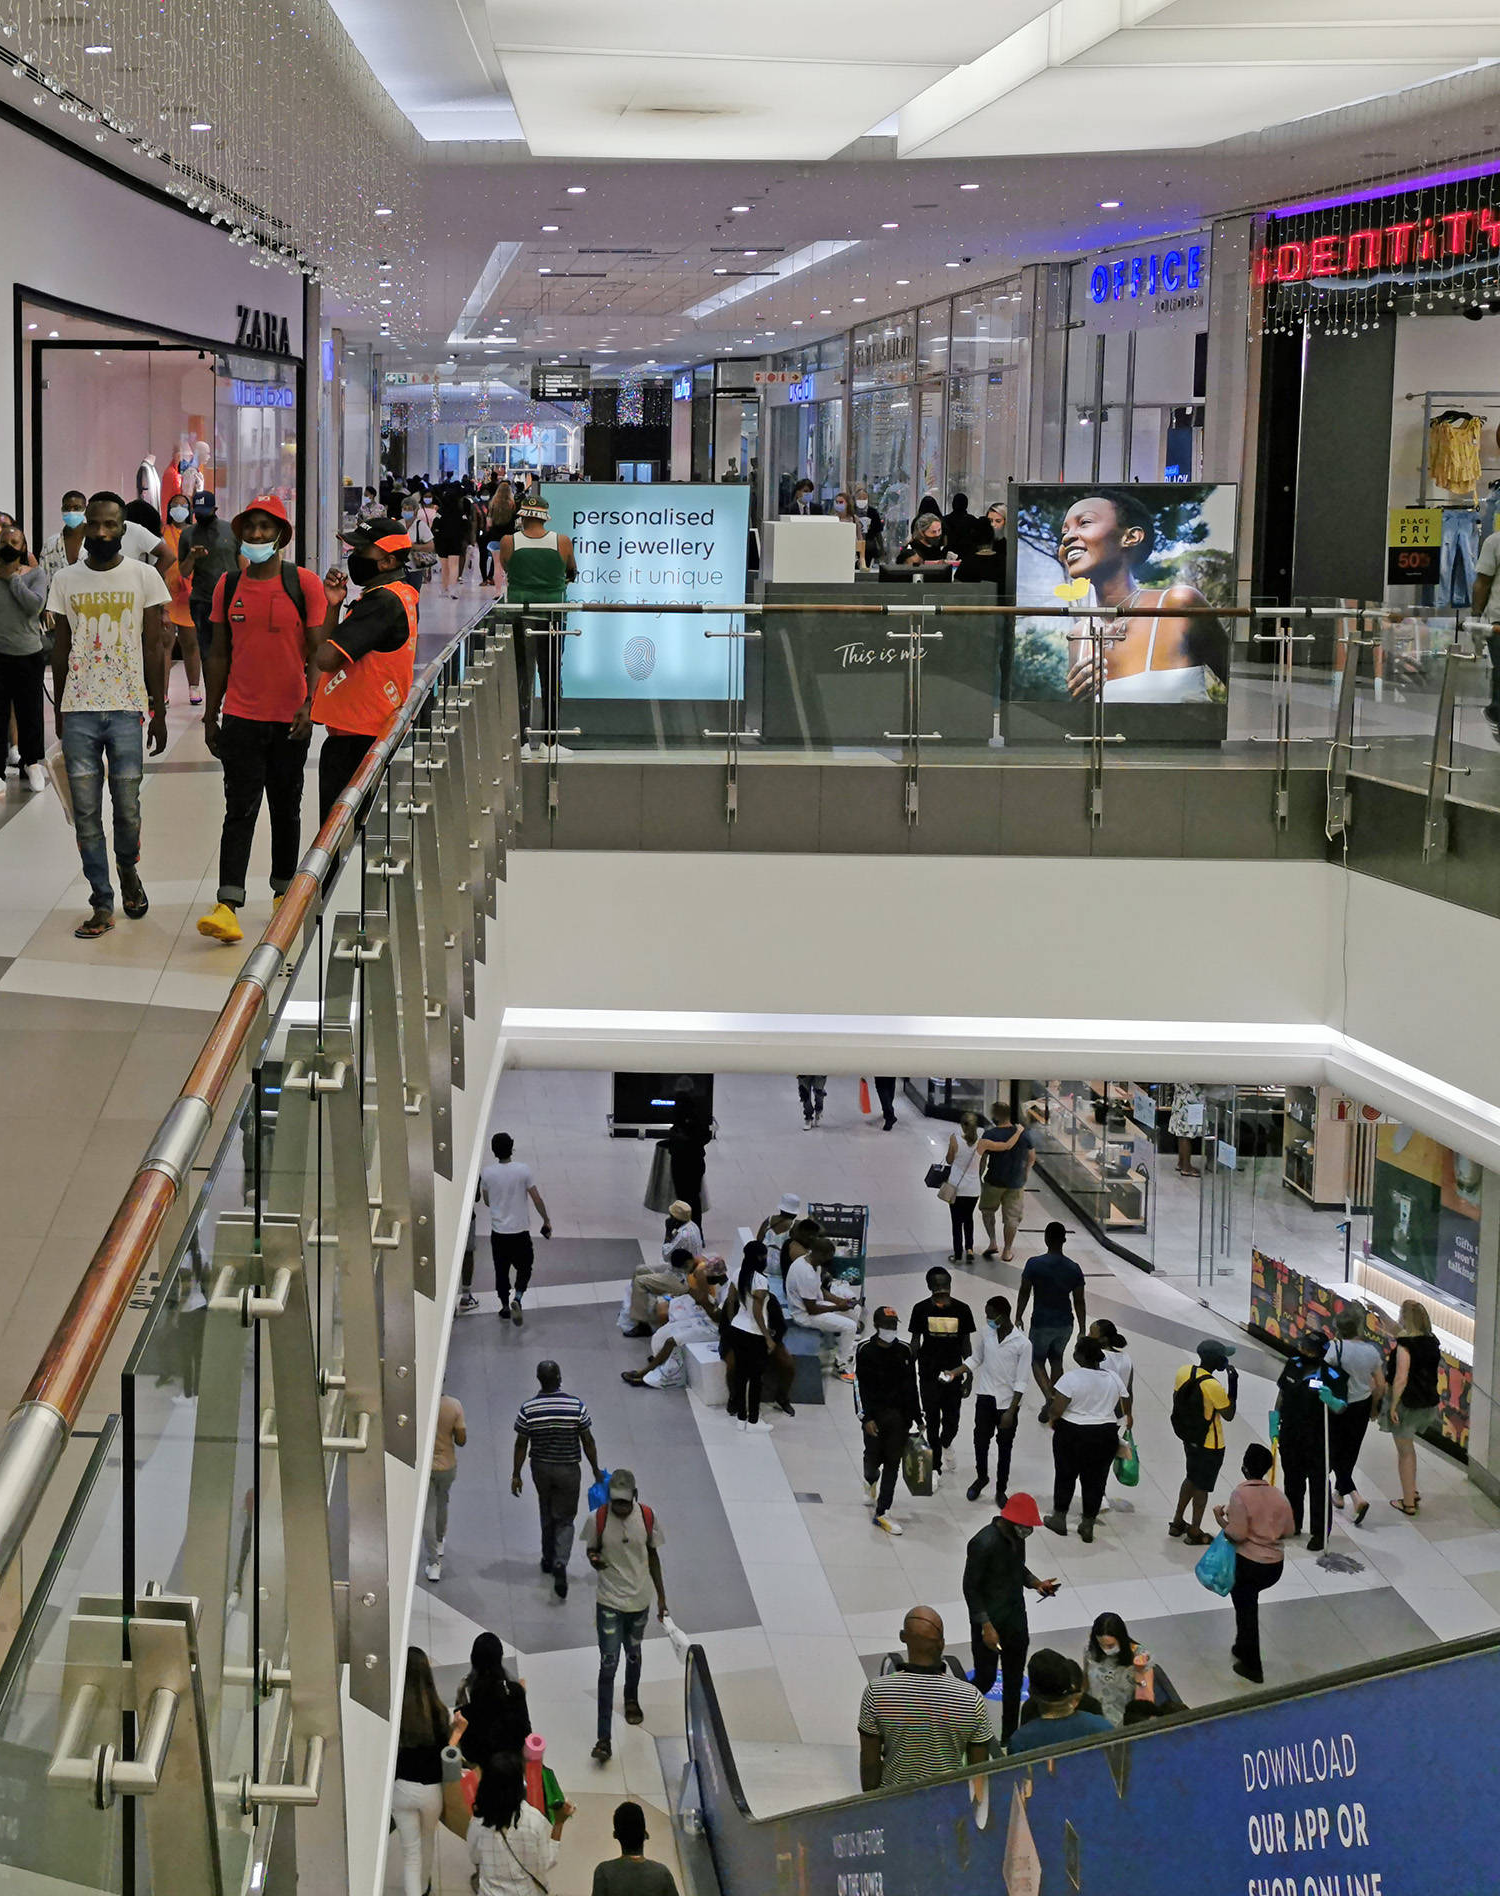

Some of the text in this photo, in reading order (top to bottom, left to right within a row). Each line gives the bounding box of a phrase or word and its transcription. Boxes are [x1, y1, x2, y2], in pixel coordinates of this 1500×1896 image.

[1090, 245, 1201, 304] OFFICE
[235, 304, 292, 356] ZARA
[573, 508, 714, 529] personalised
[1401, 526, 1429, 534] FRI
[572, 537, 715, 560] fine jewellery
[1401, 536, 1430, 544] DAY
[575, 567, 723, 589] ake it unique
[834, 642, 928, 668] This is me
[1243, 1734, 1357, 1792] DOWNLOAD
[1248, 1802, 1370, 1856] OUR APP OR
